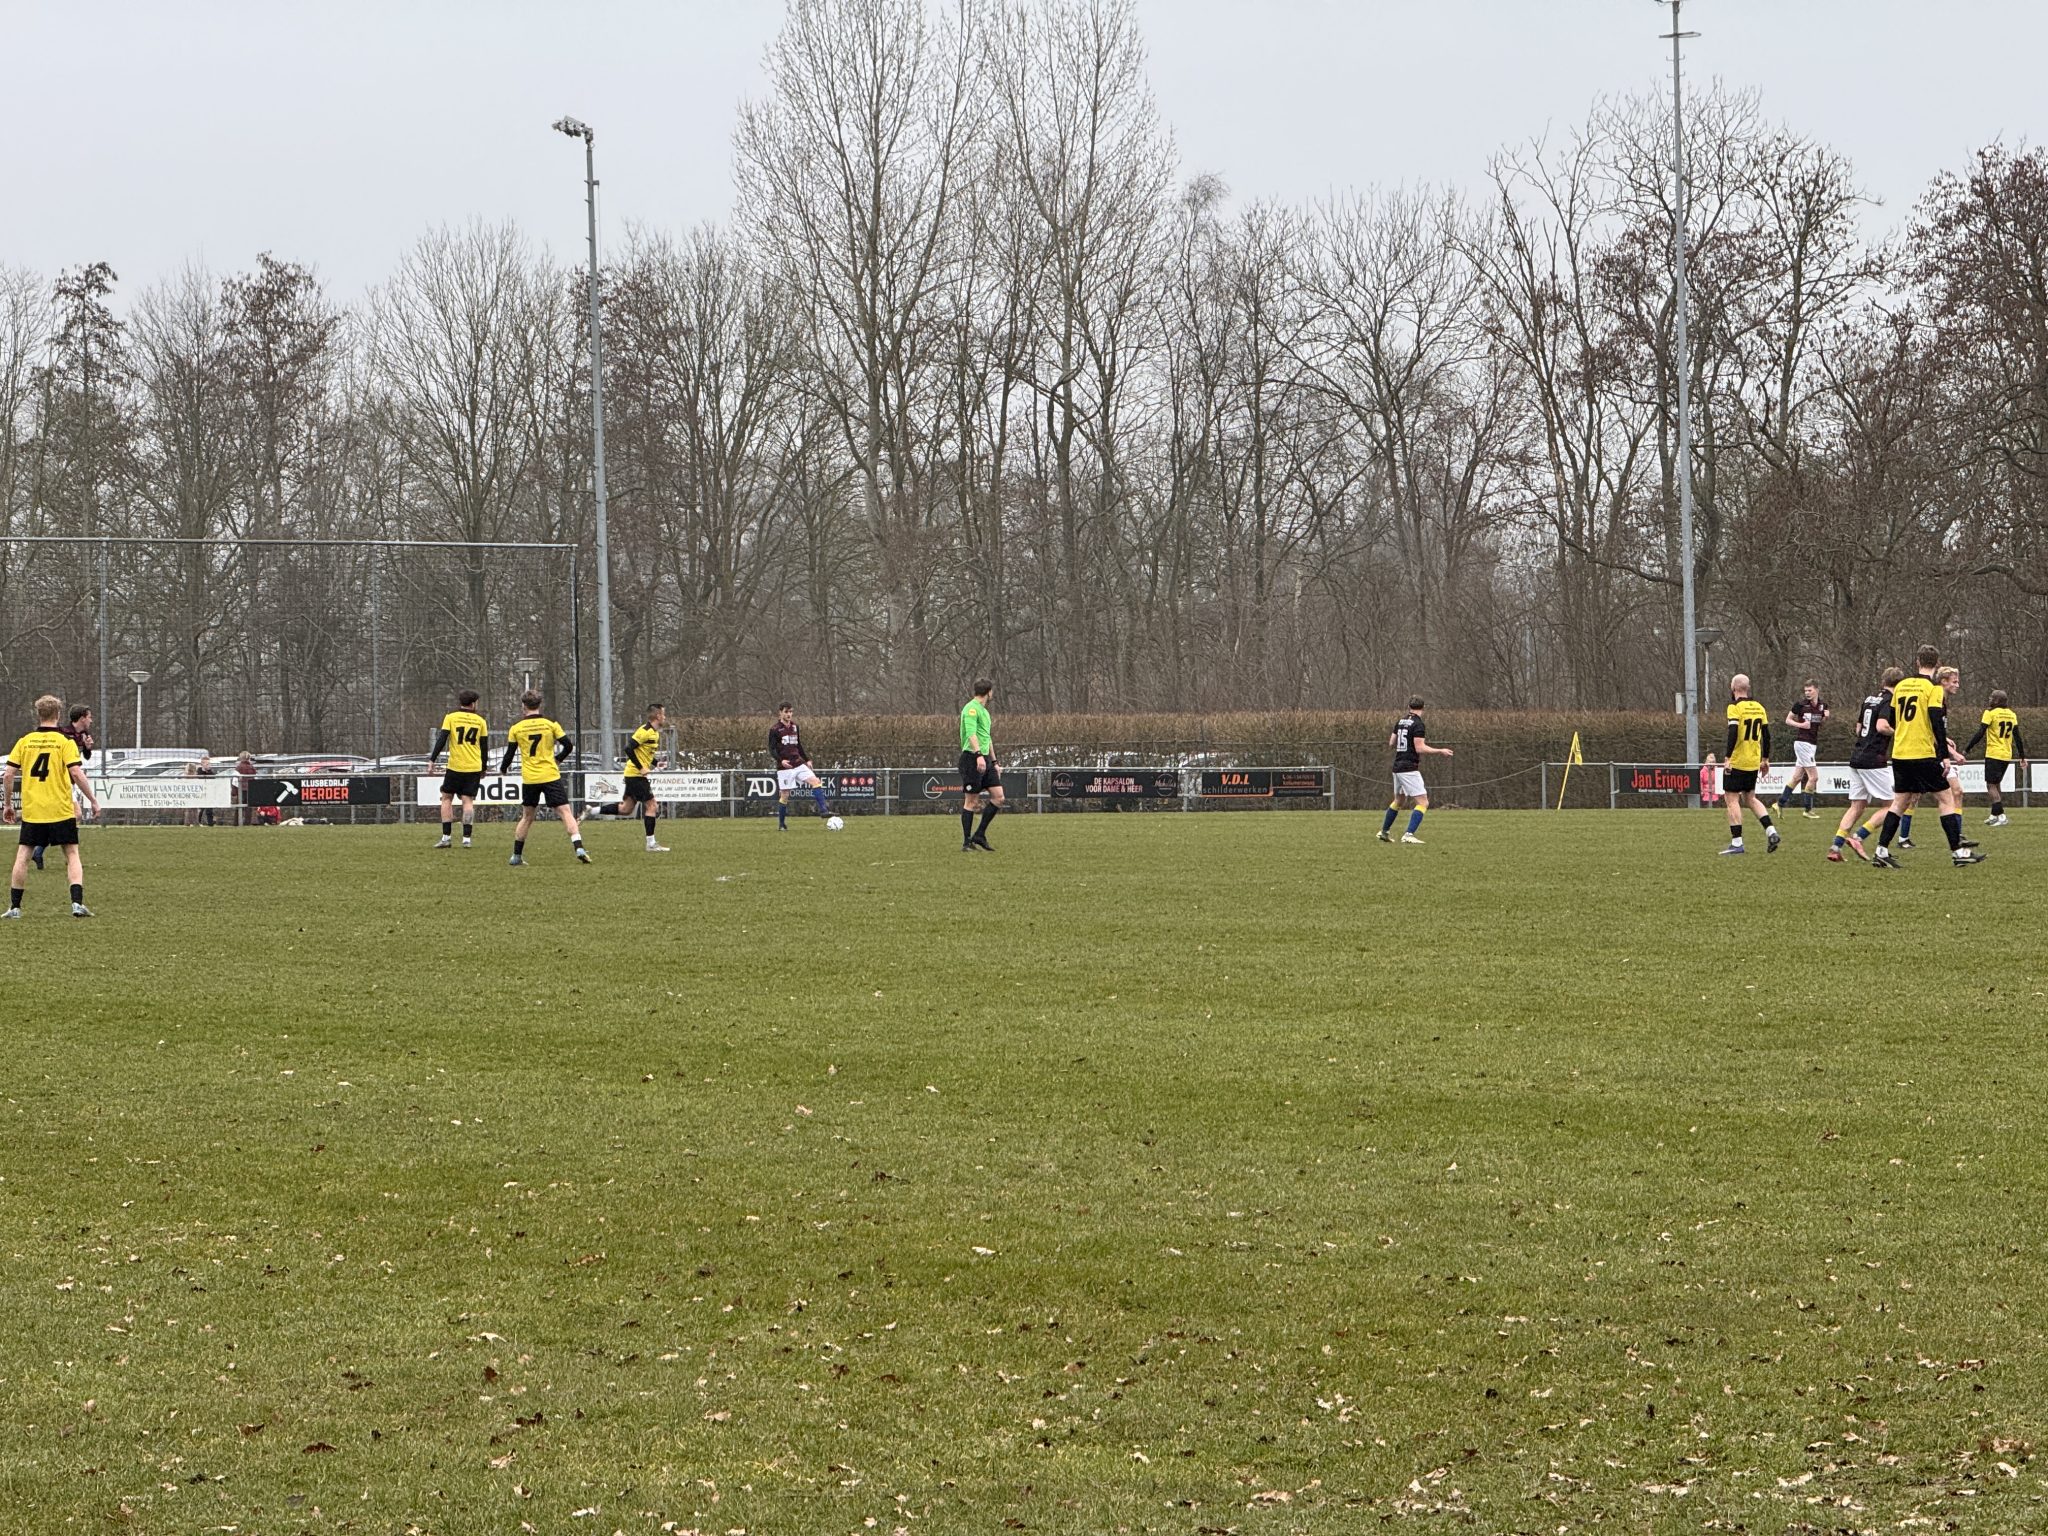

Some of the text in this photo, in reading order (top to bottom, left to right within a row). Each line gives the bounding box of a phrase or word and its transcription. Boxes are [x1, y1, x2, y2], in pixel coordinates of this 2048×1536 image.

[1897, 695, 1918, 722] 16
[1743, 718, 1763, 741] 10
[1861, 708, 1873, 738] 9
[1998, 720, 2014, 739] 12
[455, 726, 479, 745] 14
[528, 733, 543, 757] 7
[30, 752, 51, 782] 4
[301, 779, 350, 788] KLUSBEDRIJF
[687, 777, 719, 785] VENEMA
[1094, 777, 1135, 785] DE KAPSALON
[1631, 769, 1690, 793] Jan Eringa
[1756, 774, 1783, 784] oodhert
[122, 785, 158, 793] HOUTBOUW
[301, 788, 349, 800] HERDER
[1085, 785, 1102, 793] VOOR
[1103, 785, 1120, 793] DAME
[1127, 785, 1143, 793] HEER
[1202, 786, 1268, 794] schilderwerken
